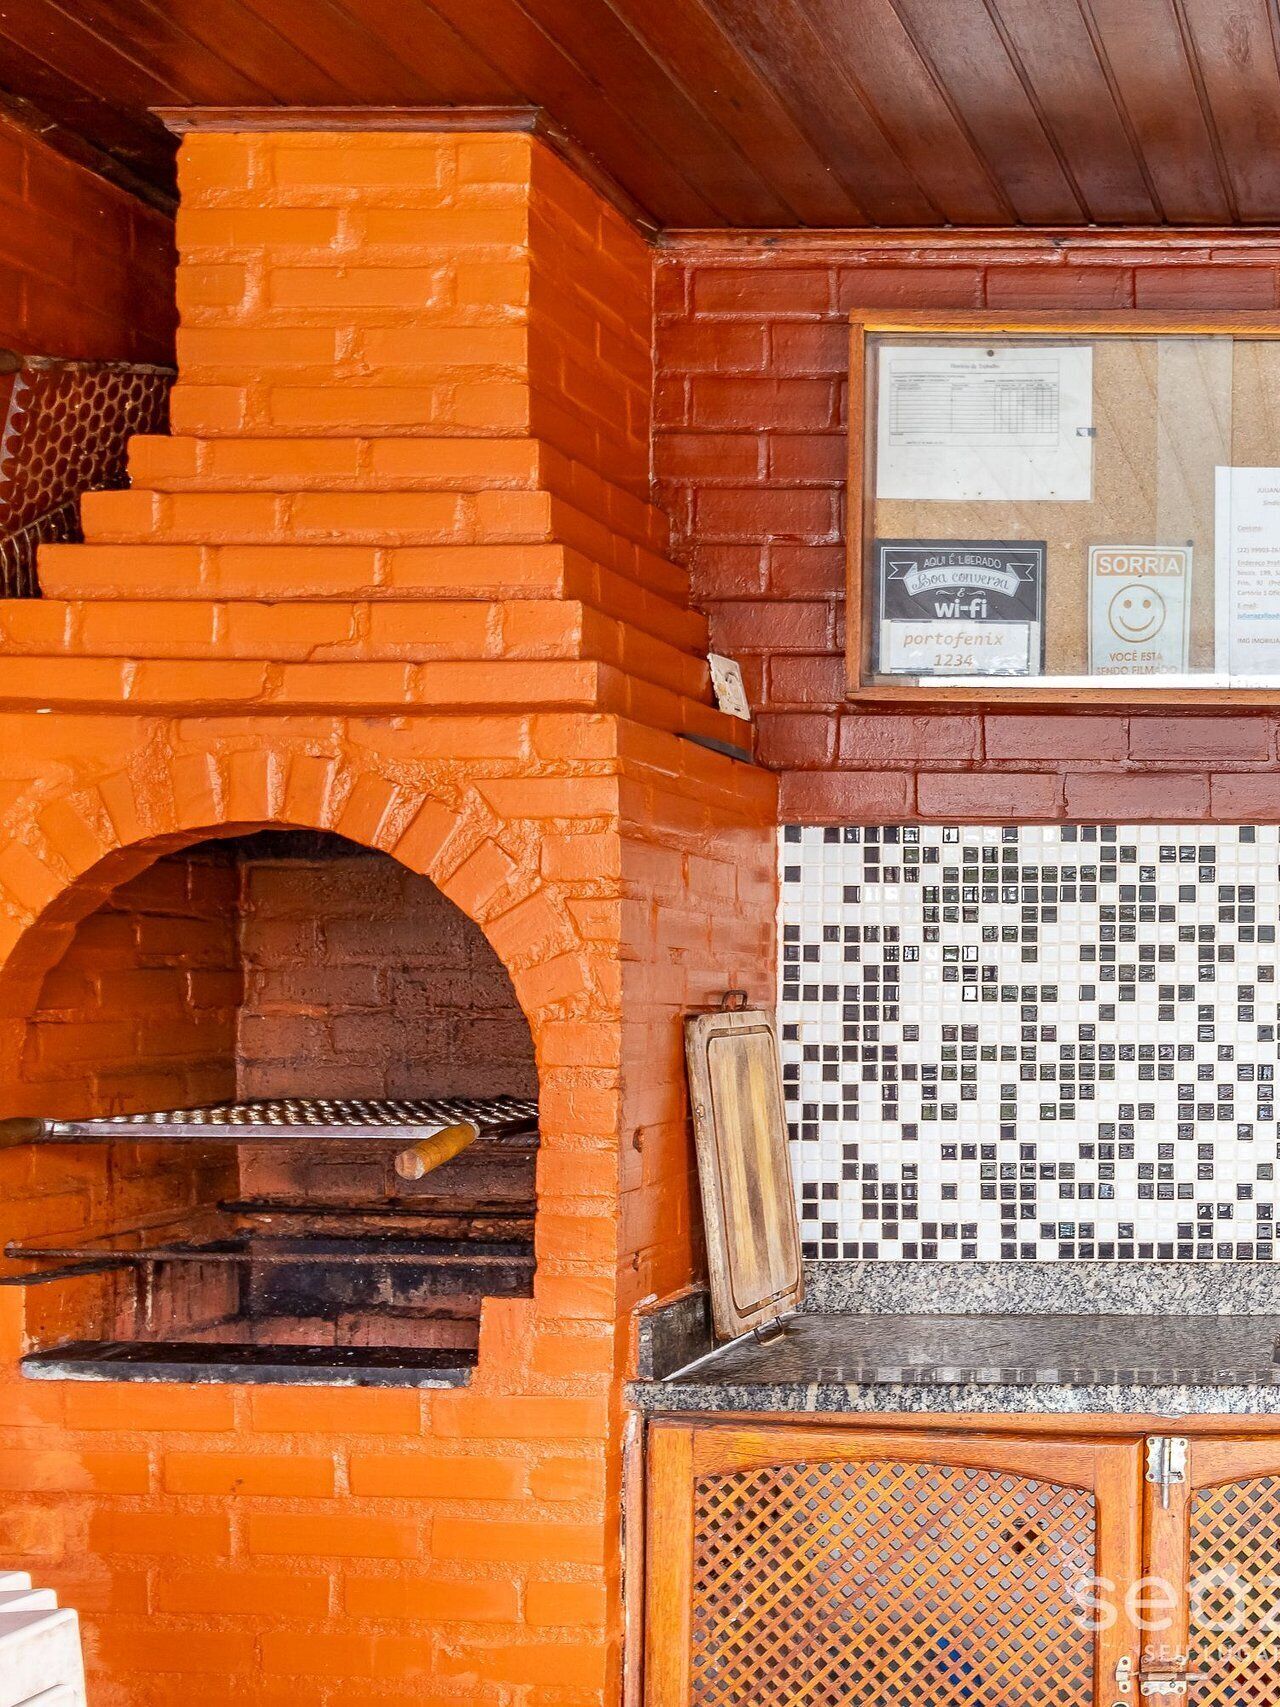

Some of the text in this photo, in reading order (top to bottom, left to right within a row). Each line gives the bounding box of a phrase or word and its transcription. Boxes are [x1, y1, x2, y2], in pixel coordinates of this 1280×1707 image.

[923, 553, 1002, 568] AQUI É LIBERADO
[1099, 556, 1181, 574] SORRIA
[911, 572, 1009, 591] Boa conversa
[934, 598, 988, 618] wi-fi
[903, 631, 1004, 649] portofenix
[933, 654, 974, 667] 1234
[1109, 650, 1138, 662] VOCÊ
[1097, 665, 1178, 675] SENDO FILMADO
